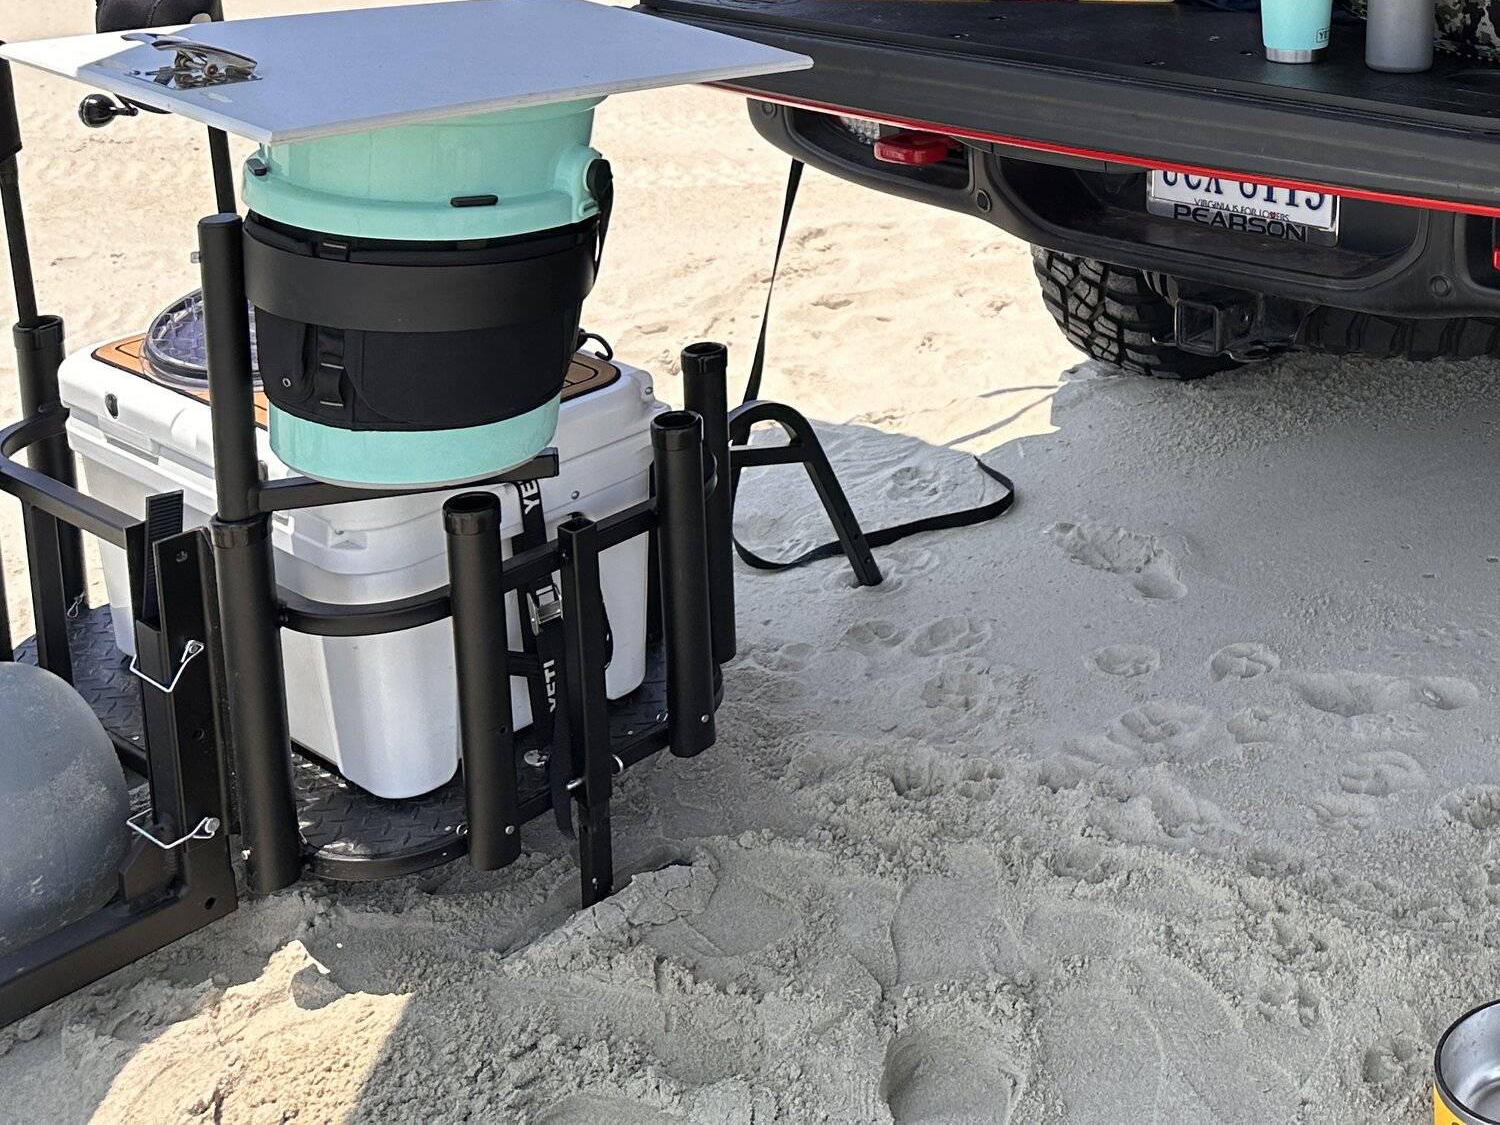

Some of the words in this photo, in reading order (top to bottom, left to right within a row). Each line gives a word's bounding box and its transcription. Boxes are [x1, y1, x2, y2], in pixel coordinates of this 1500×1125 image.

[1173, 203, 1307, 243] PEARSON
[1193, 196, 1231, 212] VIRGINIA
[1240, 205, 1257, 216] FOR
[518, 479, 540, 515] YE
